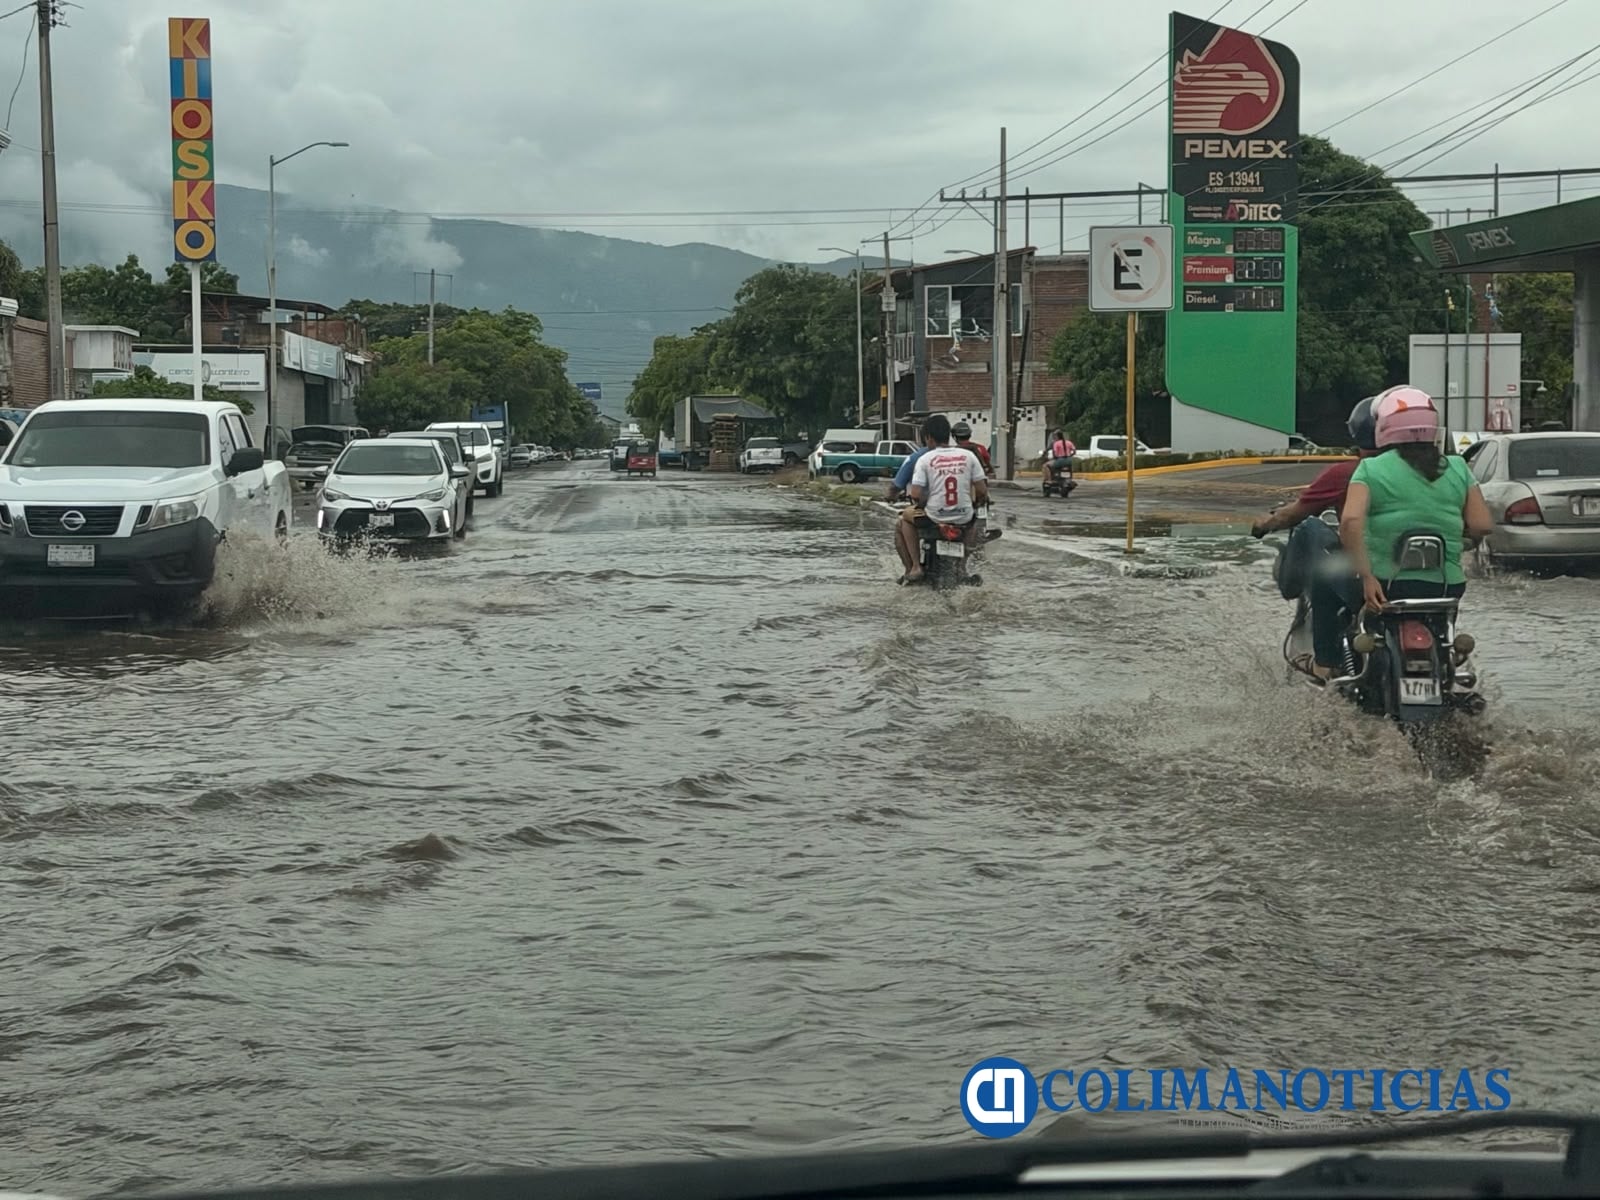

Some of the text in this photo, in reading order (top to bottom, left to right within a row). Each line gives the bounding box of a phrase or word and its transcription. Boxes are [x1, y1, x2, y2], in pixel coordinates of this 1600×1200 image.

[169, 19, 215, 260] KIOSKO
[1185, 140, 1287, 158] PEMEX
[1209, 172, 1260, 186] ES 13941
[1187, 235, 1222, 247] Magna
[1465, 228, 1515, 252] PEMEX
[1186, 265, 1229, 274] Premium
[1186, 294, 1216, 304] Diesel
[944, 476, 958, 506] 8
